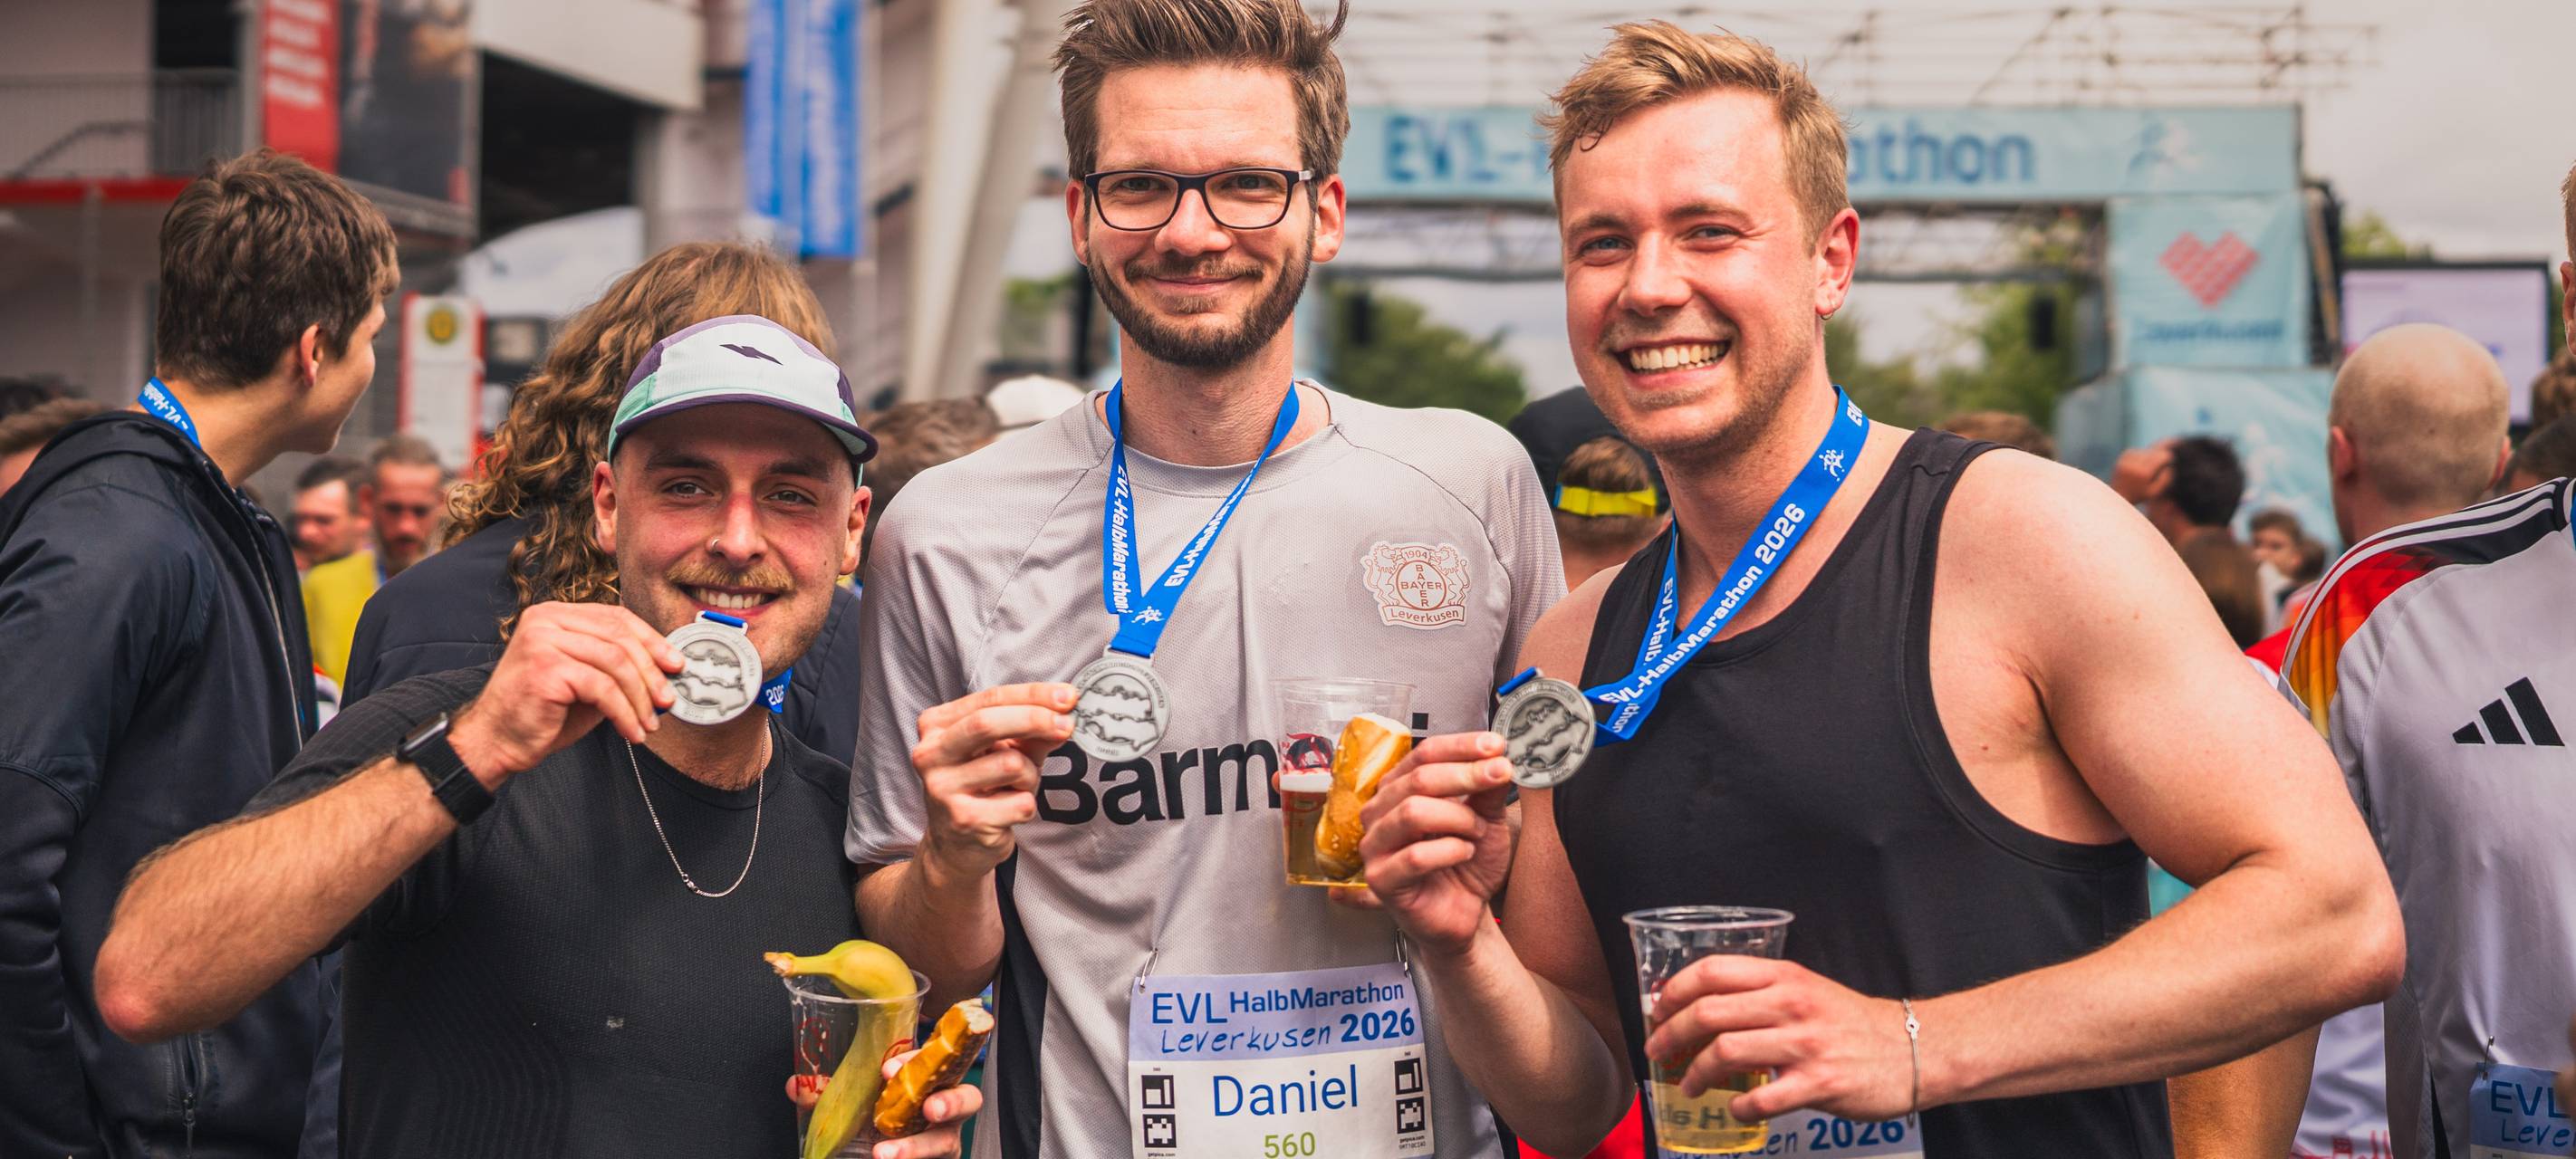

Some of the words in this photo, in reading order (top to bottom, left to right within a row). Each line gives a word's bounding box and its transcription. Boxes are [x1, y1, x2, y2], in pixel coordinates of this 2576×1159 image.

[1405, 550, 1428, 559] 1904
[1400, 581, 1443, 589] BAYER
[1598, 564, 1764, 704] EVL-HalbMarathon
[1754, 503, 1806, 566] 2026
[1390, 608, 1459, 623] Leverkusen
[1644, 577, 1674, 665] EVL-Halb
[1152, 992, 1228, 1024] EVL
[1229, 982, 1405, 1014] HalbMarathon
[1160, 1024, 1331, 1055] Leverkusen
[1340, 1008, 1415, 1043] 2026
[1212, 1063, 1358, 1117] Daniel
[2491, 1079, 2572, 1119] EVL
[1264, 1131, 1316, 1159] 560
[1806, 1117, 1905, 1151] 2026
[2501, 1118, 2576, 1147] Leve
